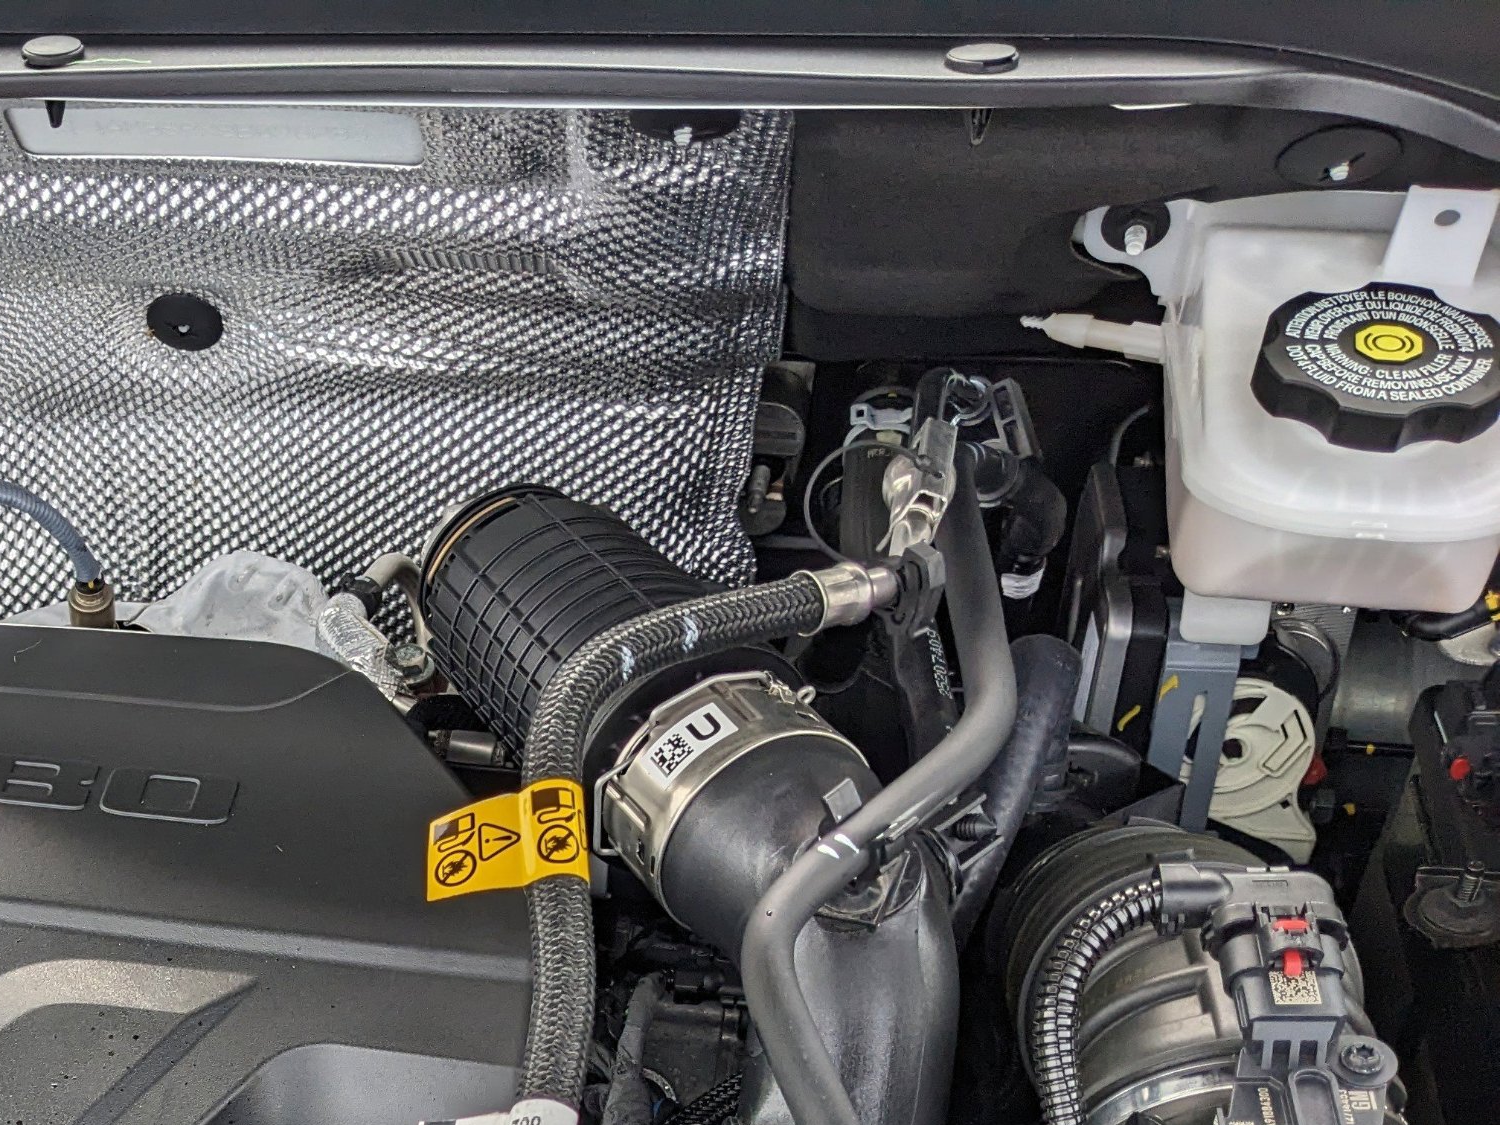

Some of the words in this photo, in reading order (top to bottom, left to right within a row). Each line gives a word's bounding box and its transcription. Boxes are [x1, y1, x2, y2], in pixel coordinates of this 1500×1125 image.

[1314, 291, 1369, 312] NETTOYER
[1371, 291, 1385, 300] LE
[1388, 292, 1440, 310] BOUCHON
[1437, 305, 1474, 324] AVANT
[1342, 302, 1364, 314] QUE
[1365, 301, 1381, 310] DU
[1382, 301, 1426, 316] LIQUIDE
[1423, 309, 1442, 322] DE
[1371, 311, 1396, 320] D'UN
[1398, 312, 1431, 330] BIDON
[1304, 344, 1326, 361] CAP
[1316, 357, 1363, 384] BEFORE
[1361, 377, 1432, 390] REMOVING
[1429, 370, 1456, 385] USE
[1448, 355, 1473, 375] ONLY
[1324, 343, 1373, 376] WARNING:
[1375, 368, 1421, 380] CLEAN
[1419, 353, 1453, 375] FILLER
[1301, 362, 1338, 385] FLUID
[1334, 380, 1376, 398] FROM
[1377, 390, 1388, 400] A
[1390, 387, 1443, 401] SEALED
[685, 712, 722, 741] U
[1349, 1090, 1373, 1111] GM
